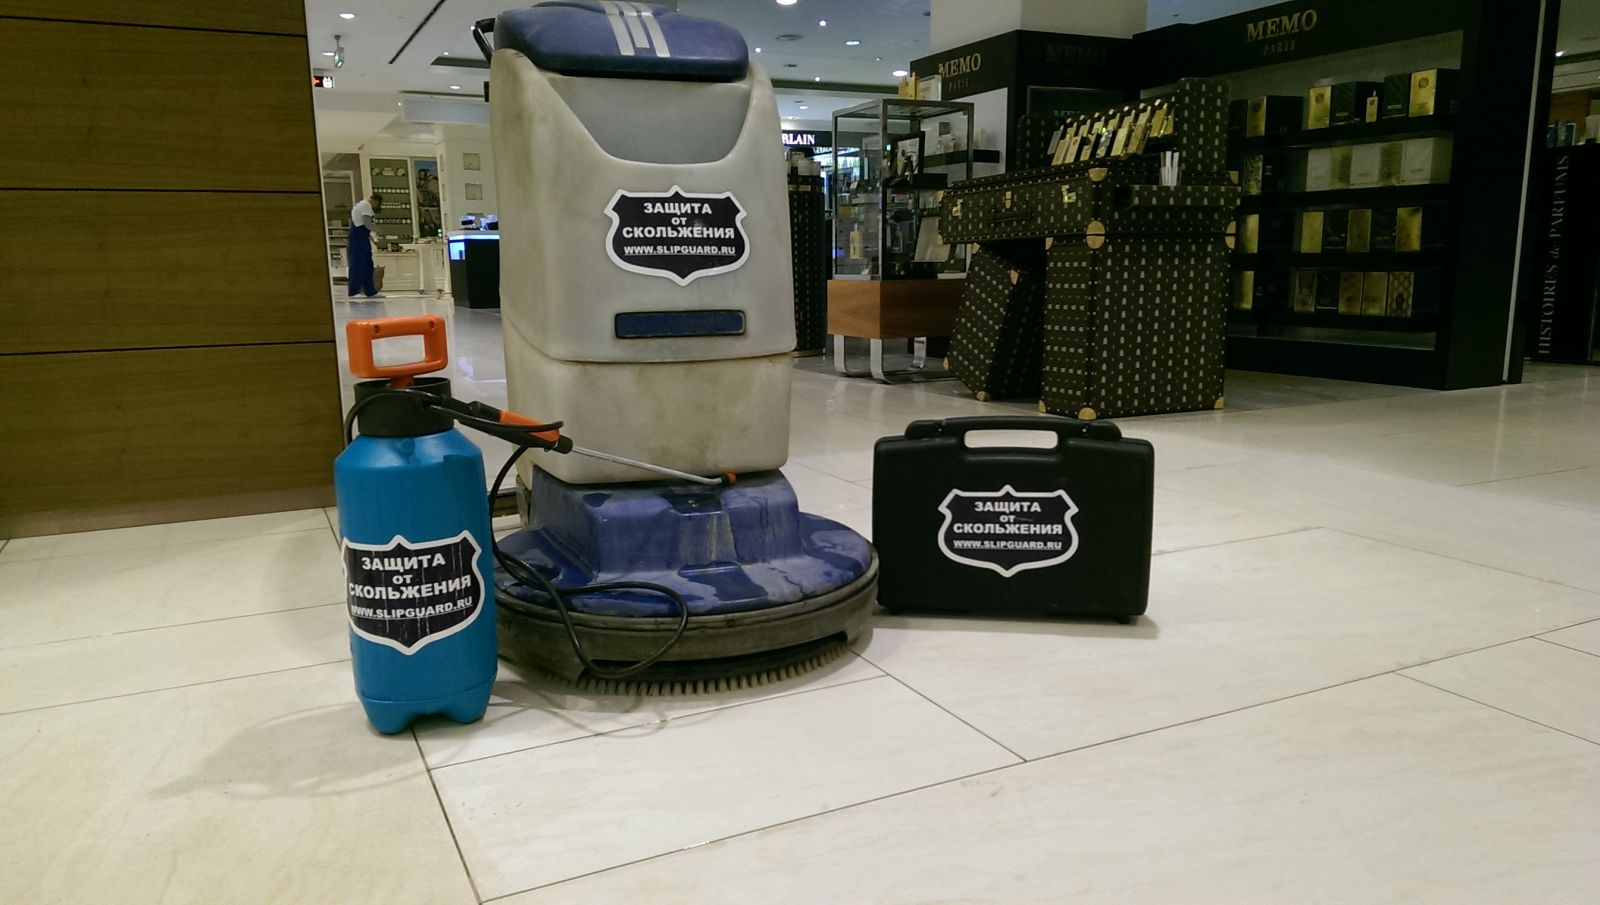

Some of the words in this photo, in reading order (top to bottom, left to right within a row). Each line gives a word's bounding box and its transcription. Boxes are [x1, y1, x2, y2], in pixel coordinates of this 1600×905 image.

[1246, 9, 1317, 42] MEMO
[1263, 40, 1296, 56] PARIS
[937, 53, 982, 78] MEMO
[948, 77, 969, 91] PARIS
[1549, 155, 1569, 237] PARFUMS
[643, 202, 712, 215] ЗАЩИТА
[622, 226, 735, 239] СКОЛЬЖЕНИЯ
[624, 245, 736, 256] WWW.SLIPGUARD.RU
[1550, 244, 1561, 259] de
[1538, 265, 1558, 354] HISTOIRES
[974, 501, 1041, 514] ЗАЩИТА
[952, 523, 1063, 535] СКОЛЬЖЕНИЯ
[953, 540, 1062, 550] WWW.SLIPGUARD.RU
[361, 553, 446, 572] ЗАЩИТА
[348, 574, 472, 600] СКОЛЬЖЕНИЯ
[350, 596, 473, 620] WWW.SLIPGUARD.RU
